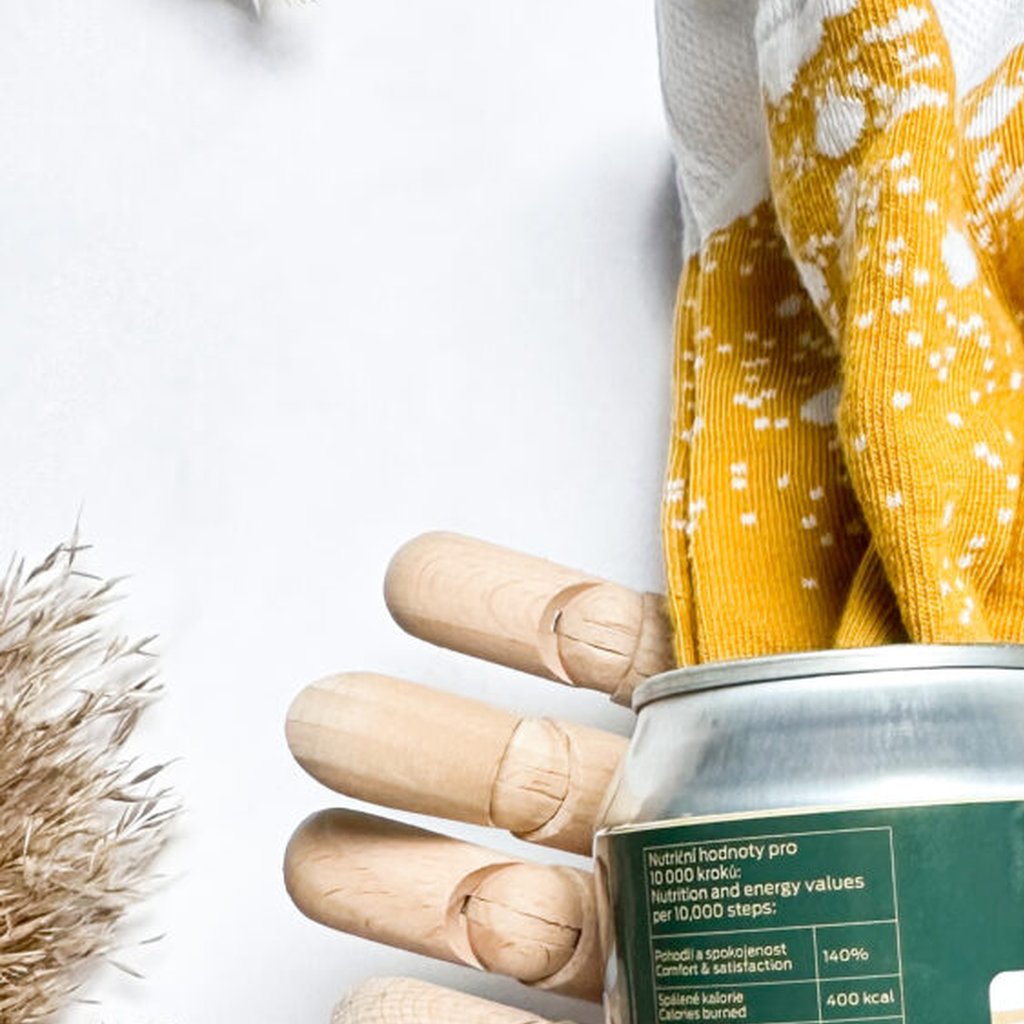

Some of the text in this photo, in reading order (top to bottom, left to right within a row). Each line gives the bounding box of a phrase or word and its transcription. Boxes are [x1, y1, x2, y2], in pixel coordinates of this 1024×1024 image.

[698, 845, 763, 863] hodnoty
[768, 842, 798, 859] pro
[697, 864, 742, 881] kroků:
[651, 874, 865, 904] Nutrition and energy values
[653, 901, 777, 925] per 10,000 steps:
[696, 949, 704, 961] a
[705, 943, 787, 963] spokojenost
[823, 947, 870, 963] 140%
[656, 958, 793, 977] Comfort & satisfaction
[701, 990, 744, 1005] kalorie
[826, 988, 896, 1007] 400 kcal
[659, 1004, 747, 1021] Calories burned
